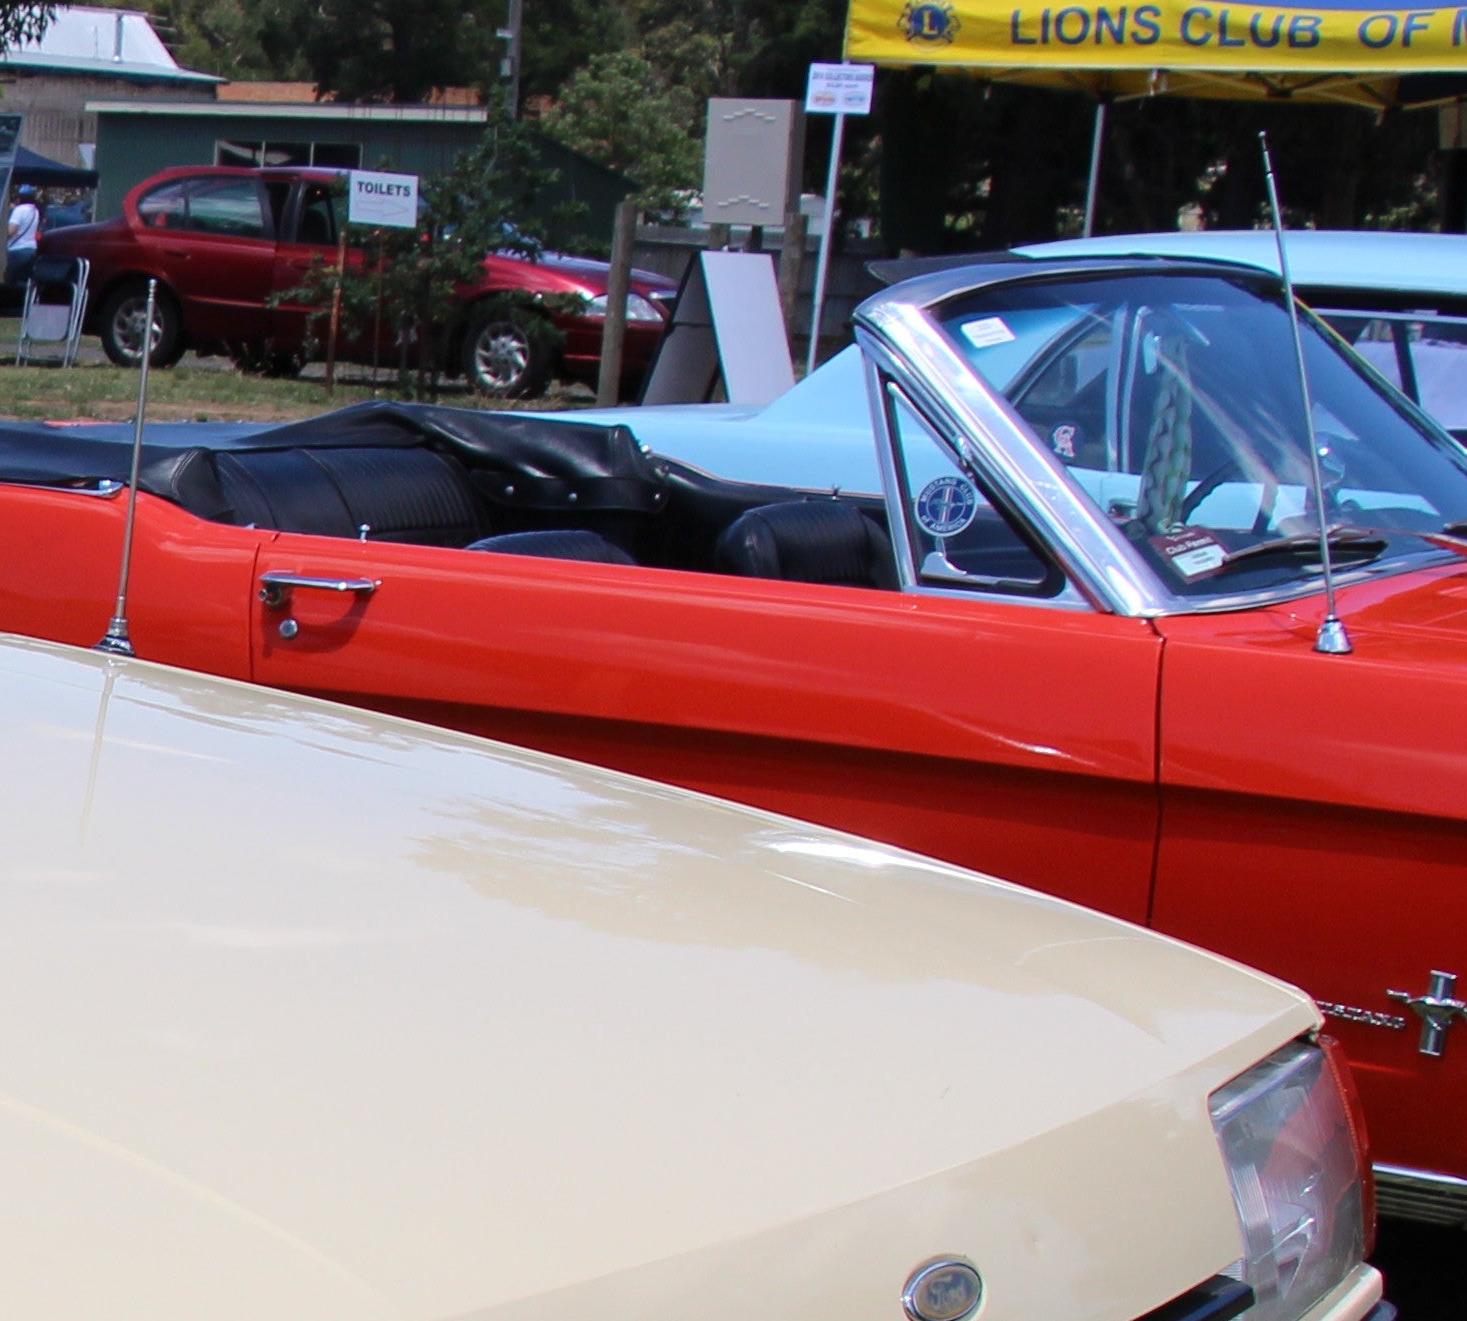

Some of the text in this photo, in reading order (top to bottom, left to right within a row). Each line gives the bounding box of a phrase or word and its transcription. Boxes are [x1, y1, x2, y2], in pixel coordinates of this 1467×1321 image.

[1011, 6, 1163, 46] LIONS
[1180, 8, 1323, 49] CLUB
[1358, 12, 1435, 49] OF
[357, 181, 411, 197] TOILETS
